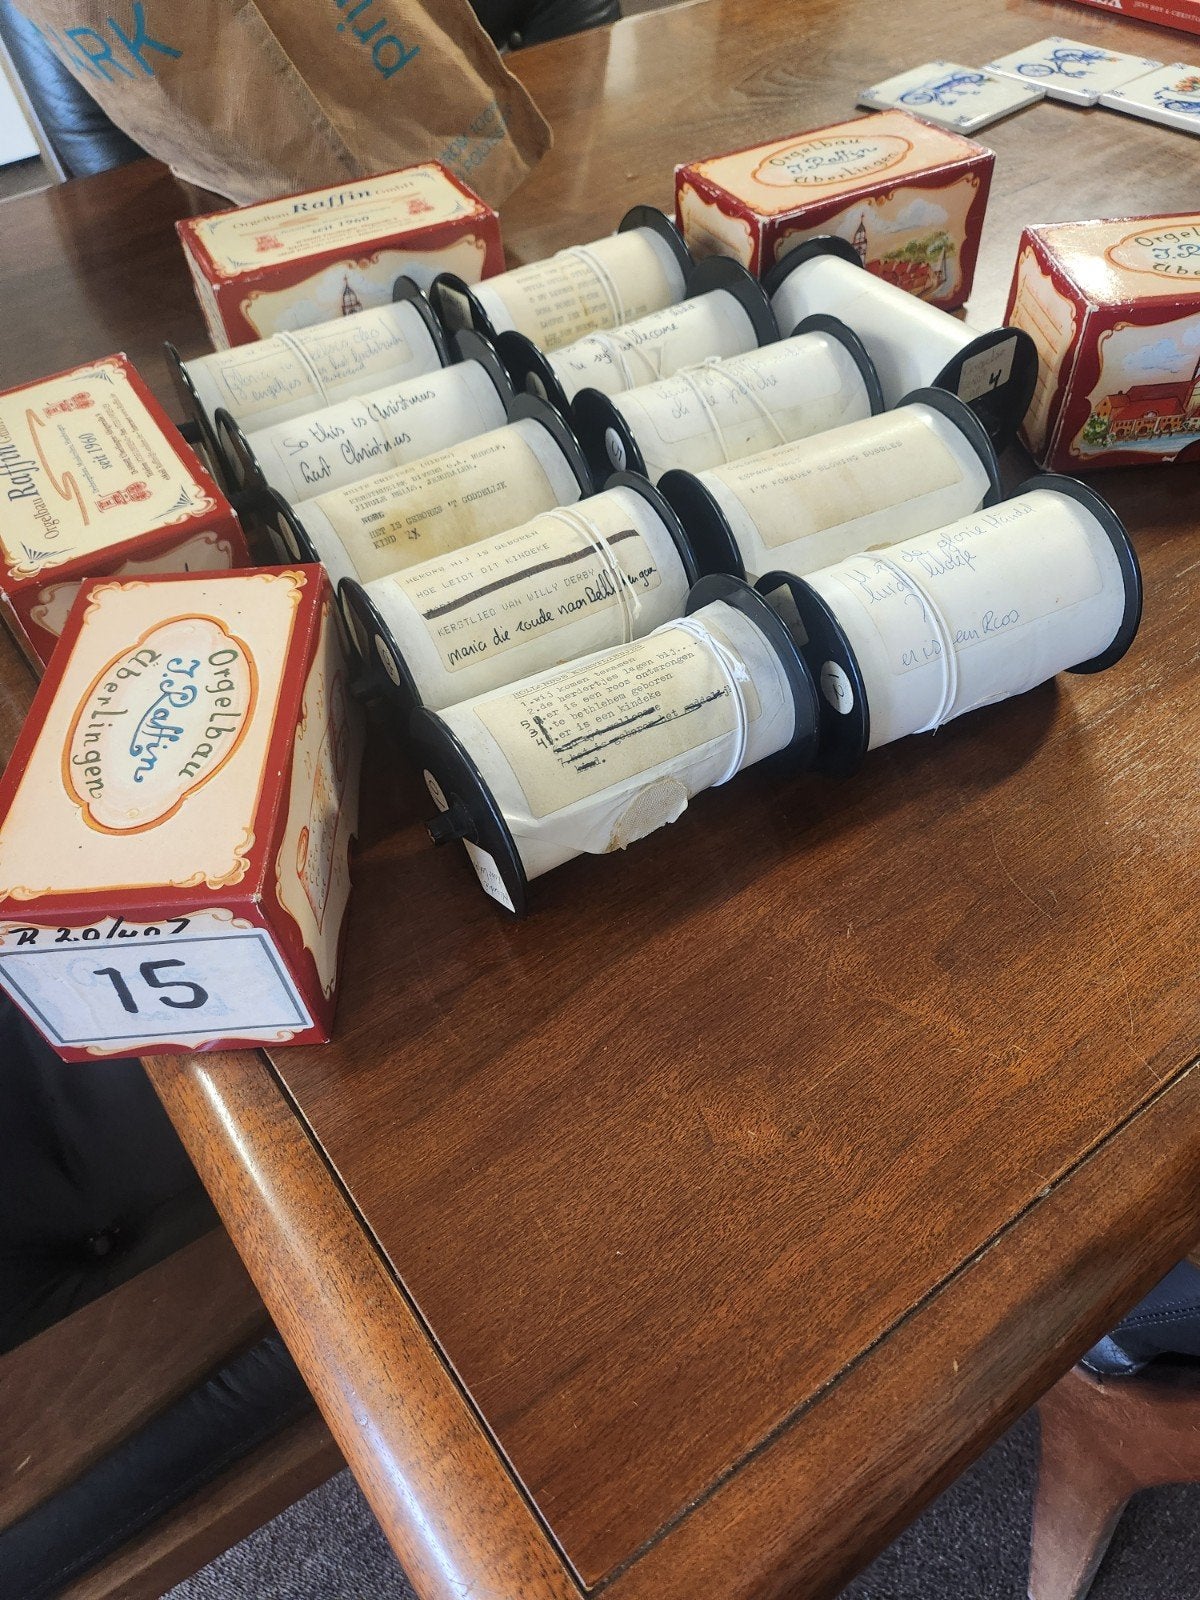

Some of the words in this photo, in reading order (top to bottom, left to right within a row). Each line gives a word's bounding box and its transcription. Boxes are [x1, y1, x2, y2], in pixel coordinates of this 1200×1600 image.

[769, 138, 860, 166] Orgelbau
[293, 190, 372, 214] Raffin
[281, 436, 310, 456] So
[308, 421, 345, 443] this
[352, 415, 368, 428] is
[366, 387, 436, 421] Christmas
[78, 432, 103, 455] 1960
[339, 431, 412, 465] Christmas
[92, 454, 112, 470] seit
[33, 497, 61, 540] Orgelbau
[368, 525, 387, 539] HET
[390, 520, 403, 531] IS
[461, 480, 509, 504] GODDELIJK
[373, 533, 397, 550] KIND
[476, 548, 489, 557] IS
[494, 529, 539, 551] GEBOREN
[415, 585, 437, 599] HOE
[442, 571, 474, 589] LEIDT
[480, 561, 500, 574] DIT
[505, 542, 551, 566] KINDEKE
[436, 607, 497, 637] KERSTLIED
[501, 596, 523, 612] VAN
[526, 582, 560, 602] WILLY
[564, 567, 596, 587] DERBY
[492, 628, 511, 645] die
[902, 649, 918, 666] er
[982, 609, 1020, 634] Roos
[526, 699, 554, 715] 2.de
[557, 672, 619, 704] herdertjes
[623, 657, 654, 674] lagen
[557, 675, 590, 693] komen
[564, 700, 577, 710] is
[582, 690, 602, 703] een
[569, 691, 626, 721] bethlehem
[630, 671, 673, 697] geboren
[72, 649, 162, 799] Überlingen
[179, 649, 242, 778] Orgelbau
[520, 719, 531, 730] 5
[576, 720, 590, 731] is
[594, 710, 615, 723] een
[618, 689, 662, 713] kindeke
[529, 729, 539, 739] 3
[537, 738, 549, 750] 4
[92, 958, 209, 1014] 15
